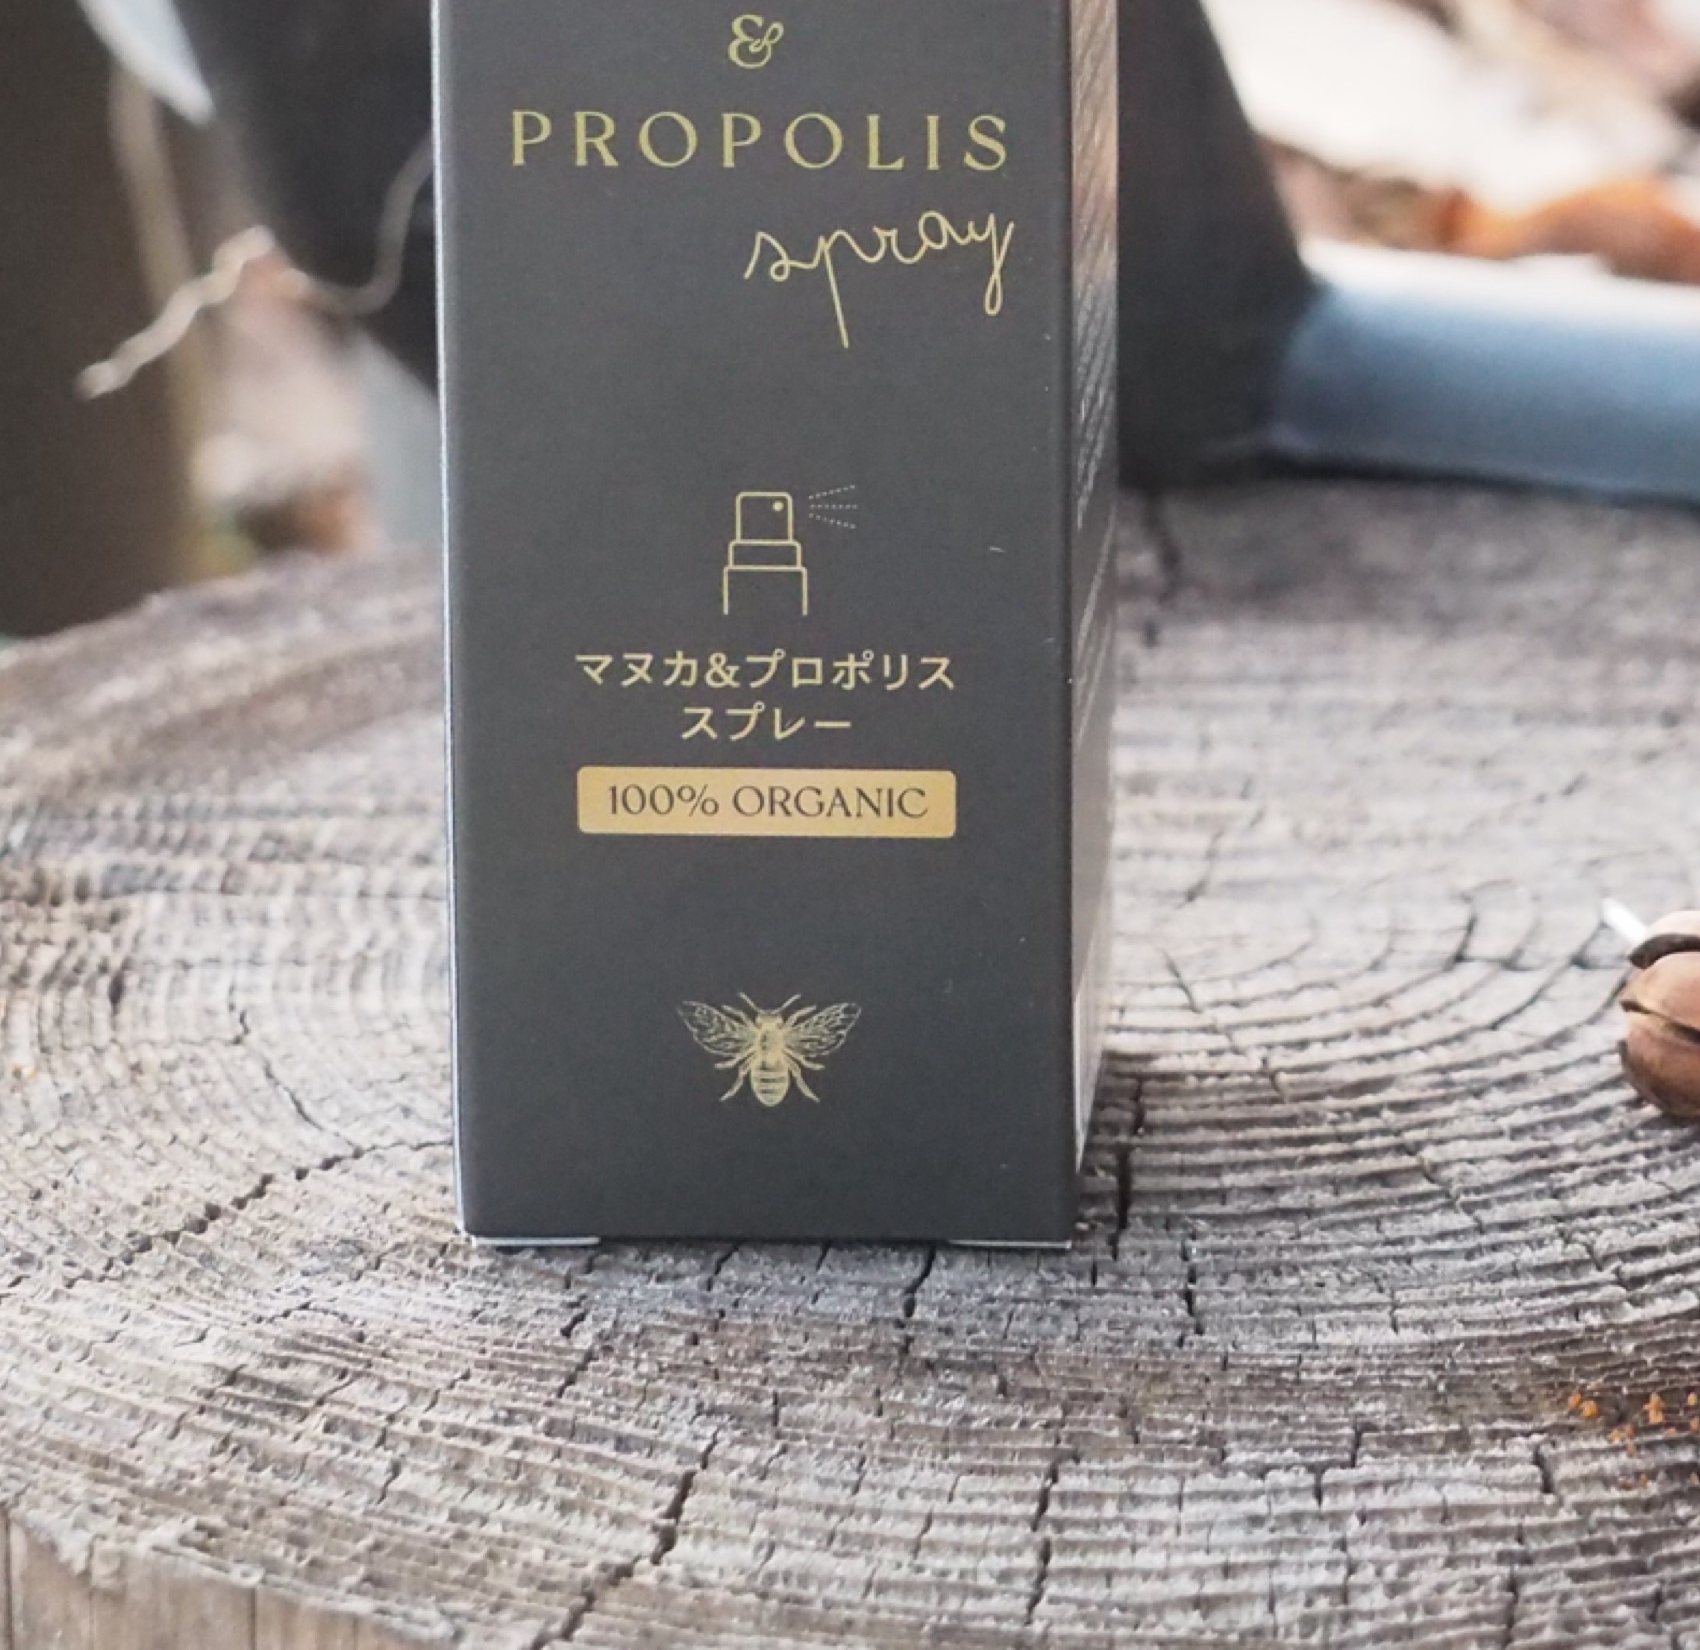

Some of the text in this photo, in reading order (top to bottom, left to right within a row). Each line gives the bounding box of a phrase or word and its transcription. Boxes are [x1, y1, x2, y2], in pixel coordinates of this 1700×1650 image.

[728, 13, 785, 70] &
[510, 110, 1008, 172] PROPOLIS
[743, 210, 1015, 350] spray
[575, 648, 956, 692] マヌカ&プロポリス
[680, 700, 852, 743] スプレー
[607, 784, 929, 820] 100% ORGANIC
